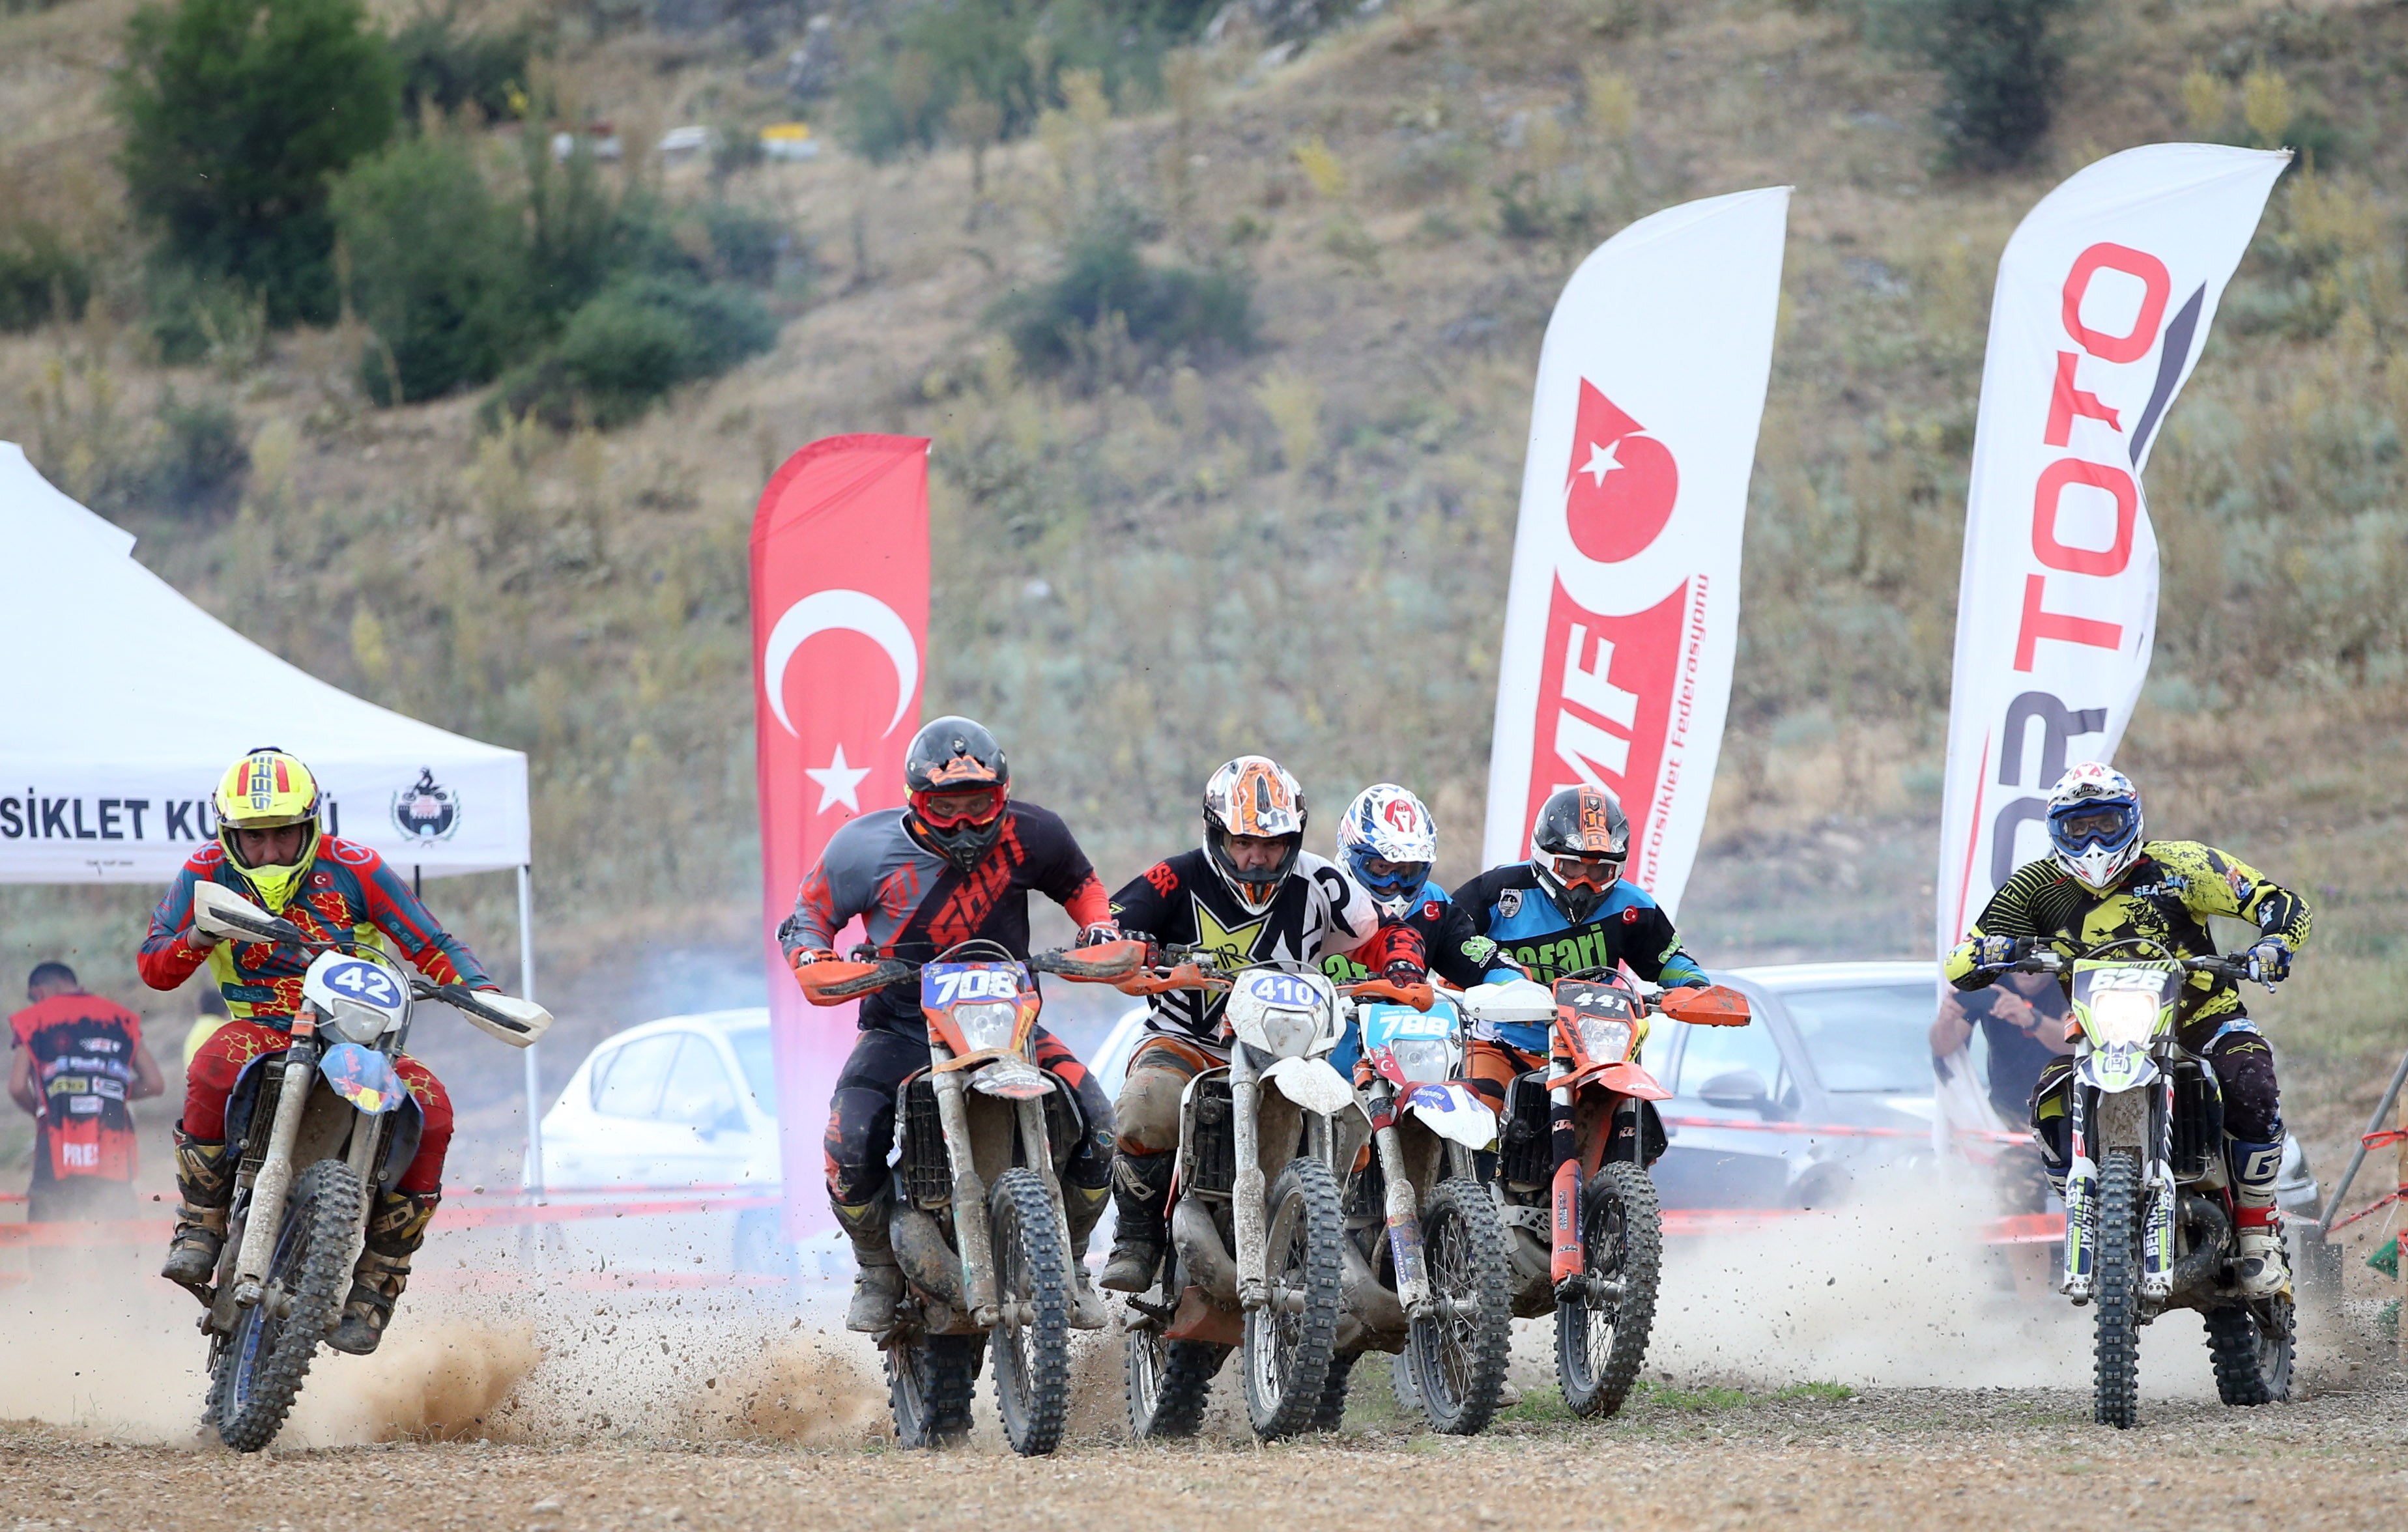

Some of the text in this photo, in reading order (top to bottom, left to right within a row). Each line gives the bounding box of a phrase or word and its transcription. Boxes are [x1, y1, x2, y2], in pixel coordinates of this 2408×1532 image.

[2013, 242, 2171, 672] TOTO
[1643, 758, 1682, 894] Motosiklet
[1671, 573, 1710, 748] Federasyonu
[2134, 874, 2189, 898] SEA TO SKY
[1500, 923, 1608, 984] afari
[334, 967, 392, 1004] 42
[934, 971, 1018, 1005] 708
[1255, 978, 1313, 1006] 410
[2087, 968, 2170, 993] 626
[1573, 992, 1627, 1012] 441
[1379, 1014, 1450, 1041] 788
[1630, 1034, 1645, 1057] DHL
[1552, 1119, 1575, 1135] KTM
[1394, 1240, 1407, 1281] DUNLOP
